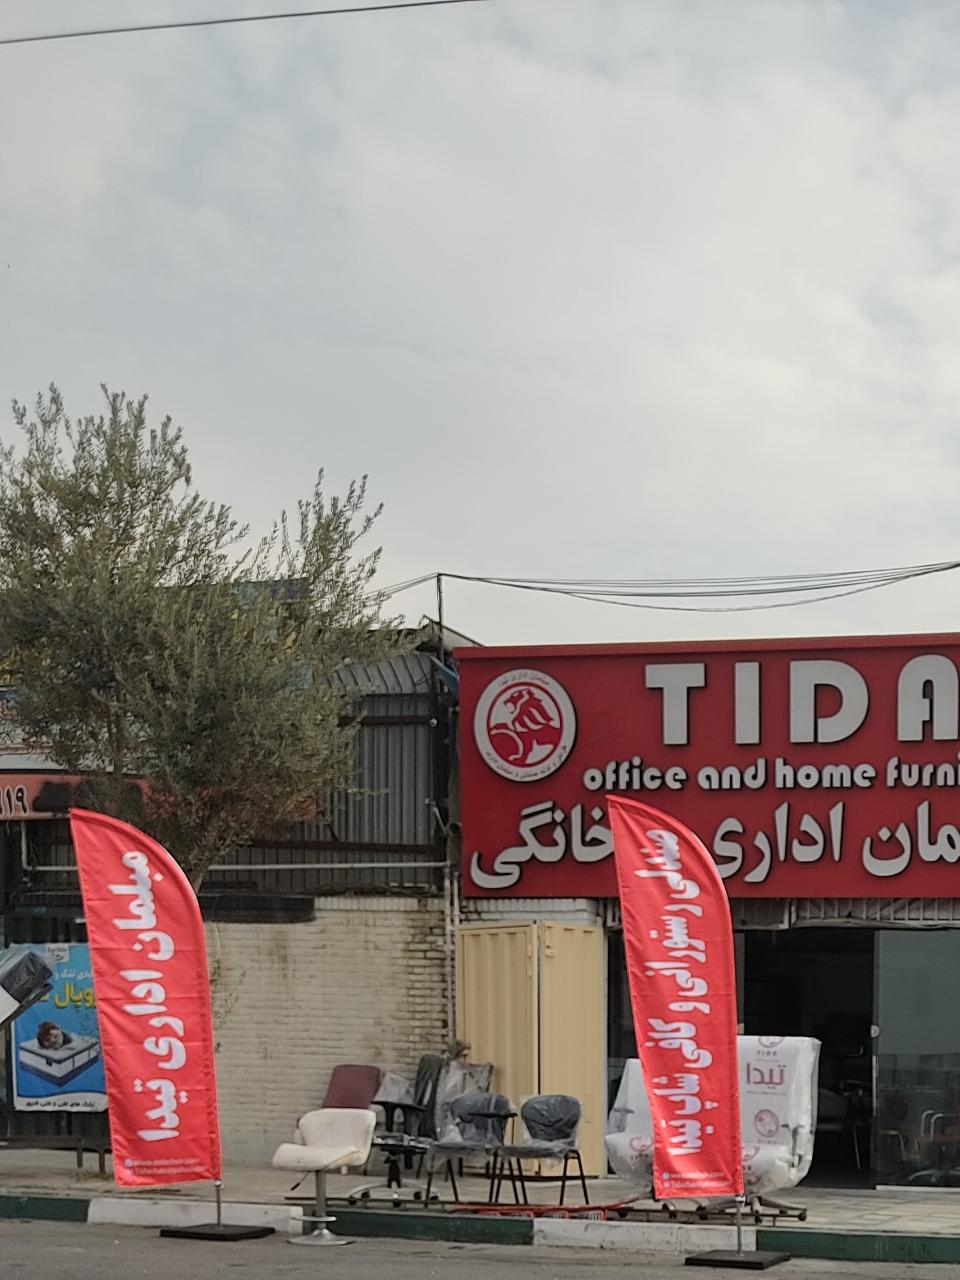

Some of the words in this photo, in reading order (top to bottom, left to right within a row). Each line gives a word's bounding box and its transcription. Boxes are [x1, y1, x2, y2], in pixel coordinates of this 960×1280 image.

[645, 653, 960, 746] TIDA
[583, 755, 688, 791] office
[697, 756, 767, 790] and
[775, 756, 876, 789] home
[470, 801, 613, 890] خانگی
[634, 828, 701, 899] صندلی
[715, 801, 844, 883] اداری
[108, 849, 174, 961] مبلمان
[645, 903, 708, 998] رستورانی
[119, 969, 187, 1070] اداری
[668, 1001, 711, 1014] و
[645, 1017, 713, 1069] کافی
[746, 1062, 787, 1090] تیدا
[134, 1077, 189, 1142] تیدا
[653, 1073, 719, 1116] شاپ
[661, 1118, 714, 1156] تیدا
